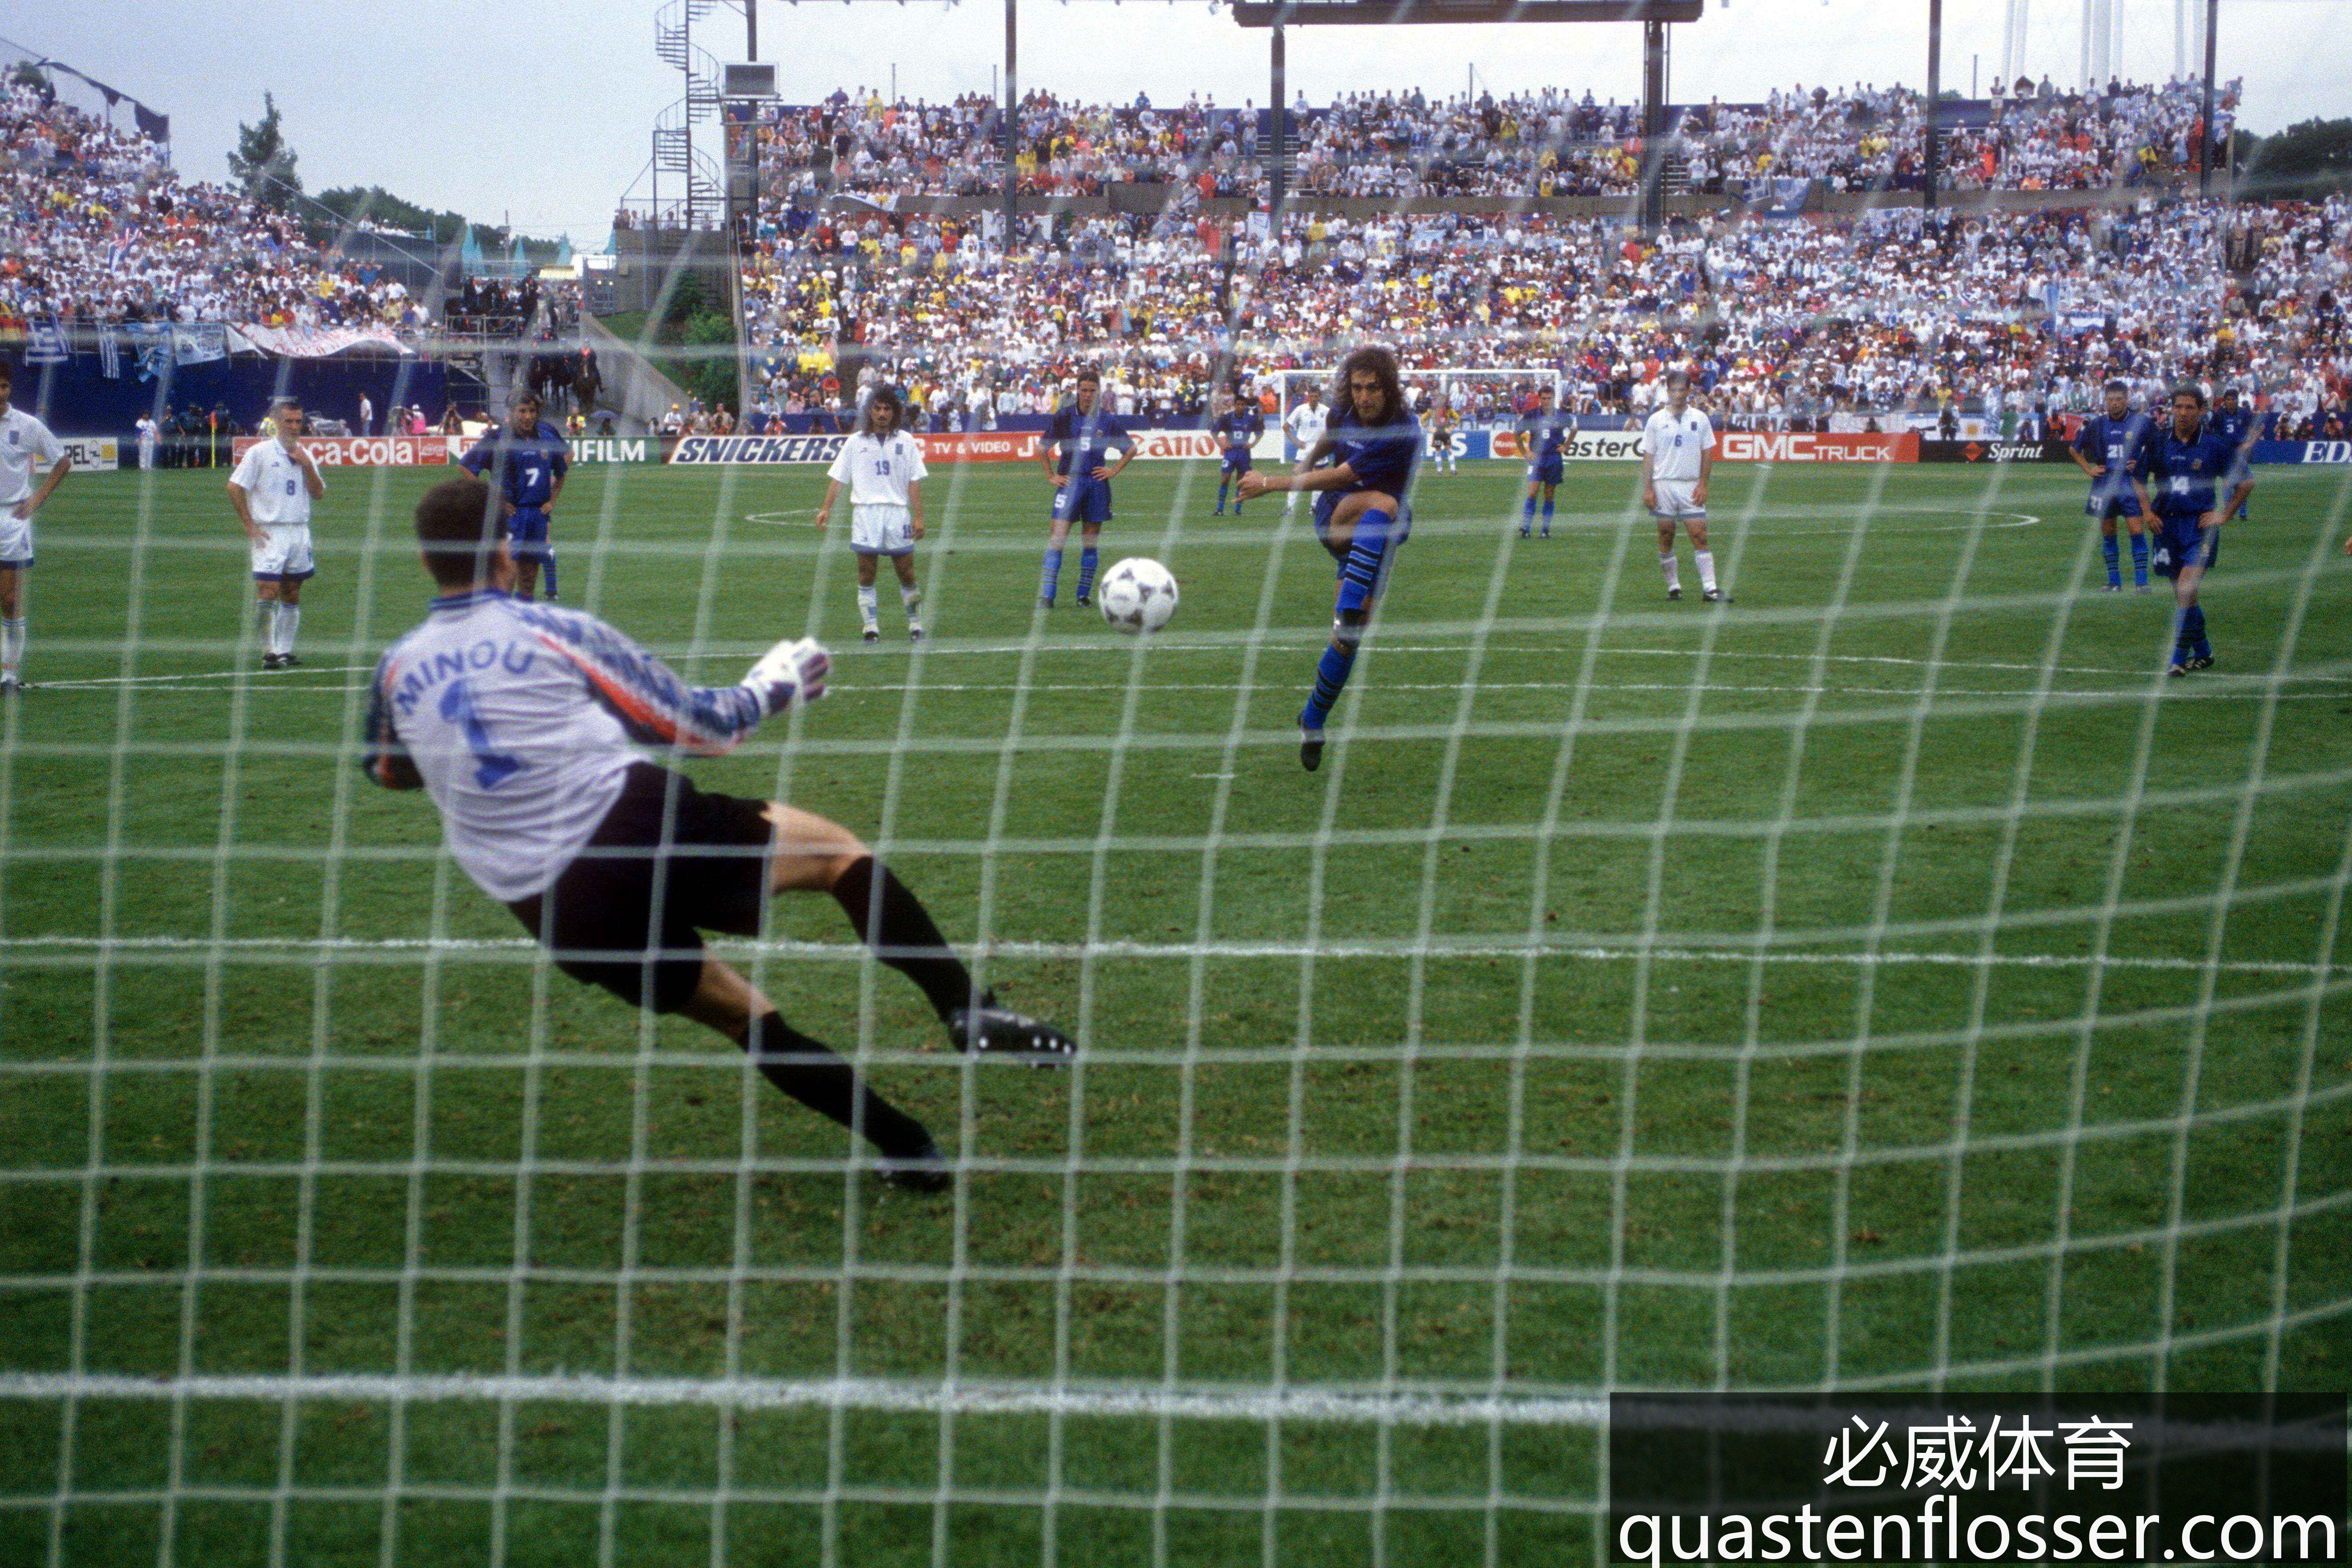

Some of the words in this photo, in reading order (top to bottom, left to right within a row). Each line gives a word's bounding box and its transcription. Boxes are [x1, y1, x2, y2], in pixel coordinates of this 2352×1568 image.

[63, 445, 90, 465] PEL
[308, 438, 413, 465] ca-Cola
[565, 439, 645, 461] IFILM
[676, 437, 849, 462] SNICKERS
[934, 442, 951, 454] TV
[971, 441, 1011, 453] VIDEO
[1128, 433, 1226, 457] Cano
[1564, 437, 1646, 457] asterC
[1722, 434, 1817, 460] GMC
[1814, 446, 1891, 461] TRUCK
[1988, 442, 2044, 462] Sprint
[2107, 444, 2124, 458] 21
[2302, 441, 2352, 463] ED
[525, 468, 540, 487] 7
[875, 460, 890, 475] 19
[286, 480, 296, 496] 8
[396, 640, 535, 715] MINOU
[439, 678, 522, 790] 1
